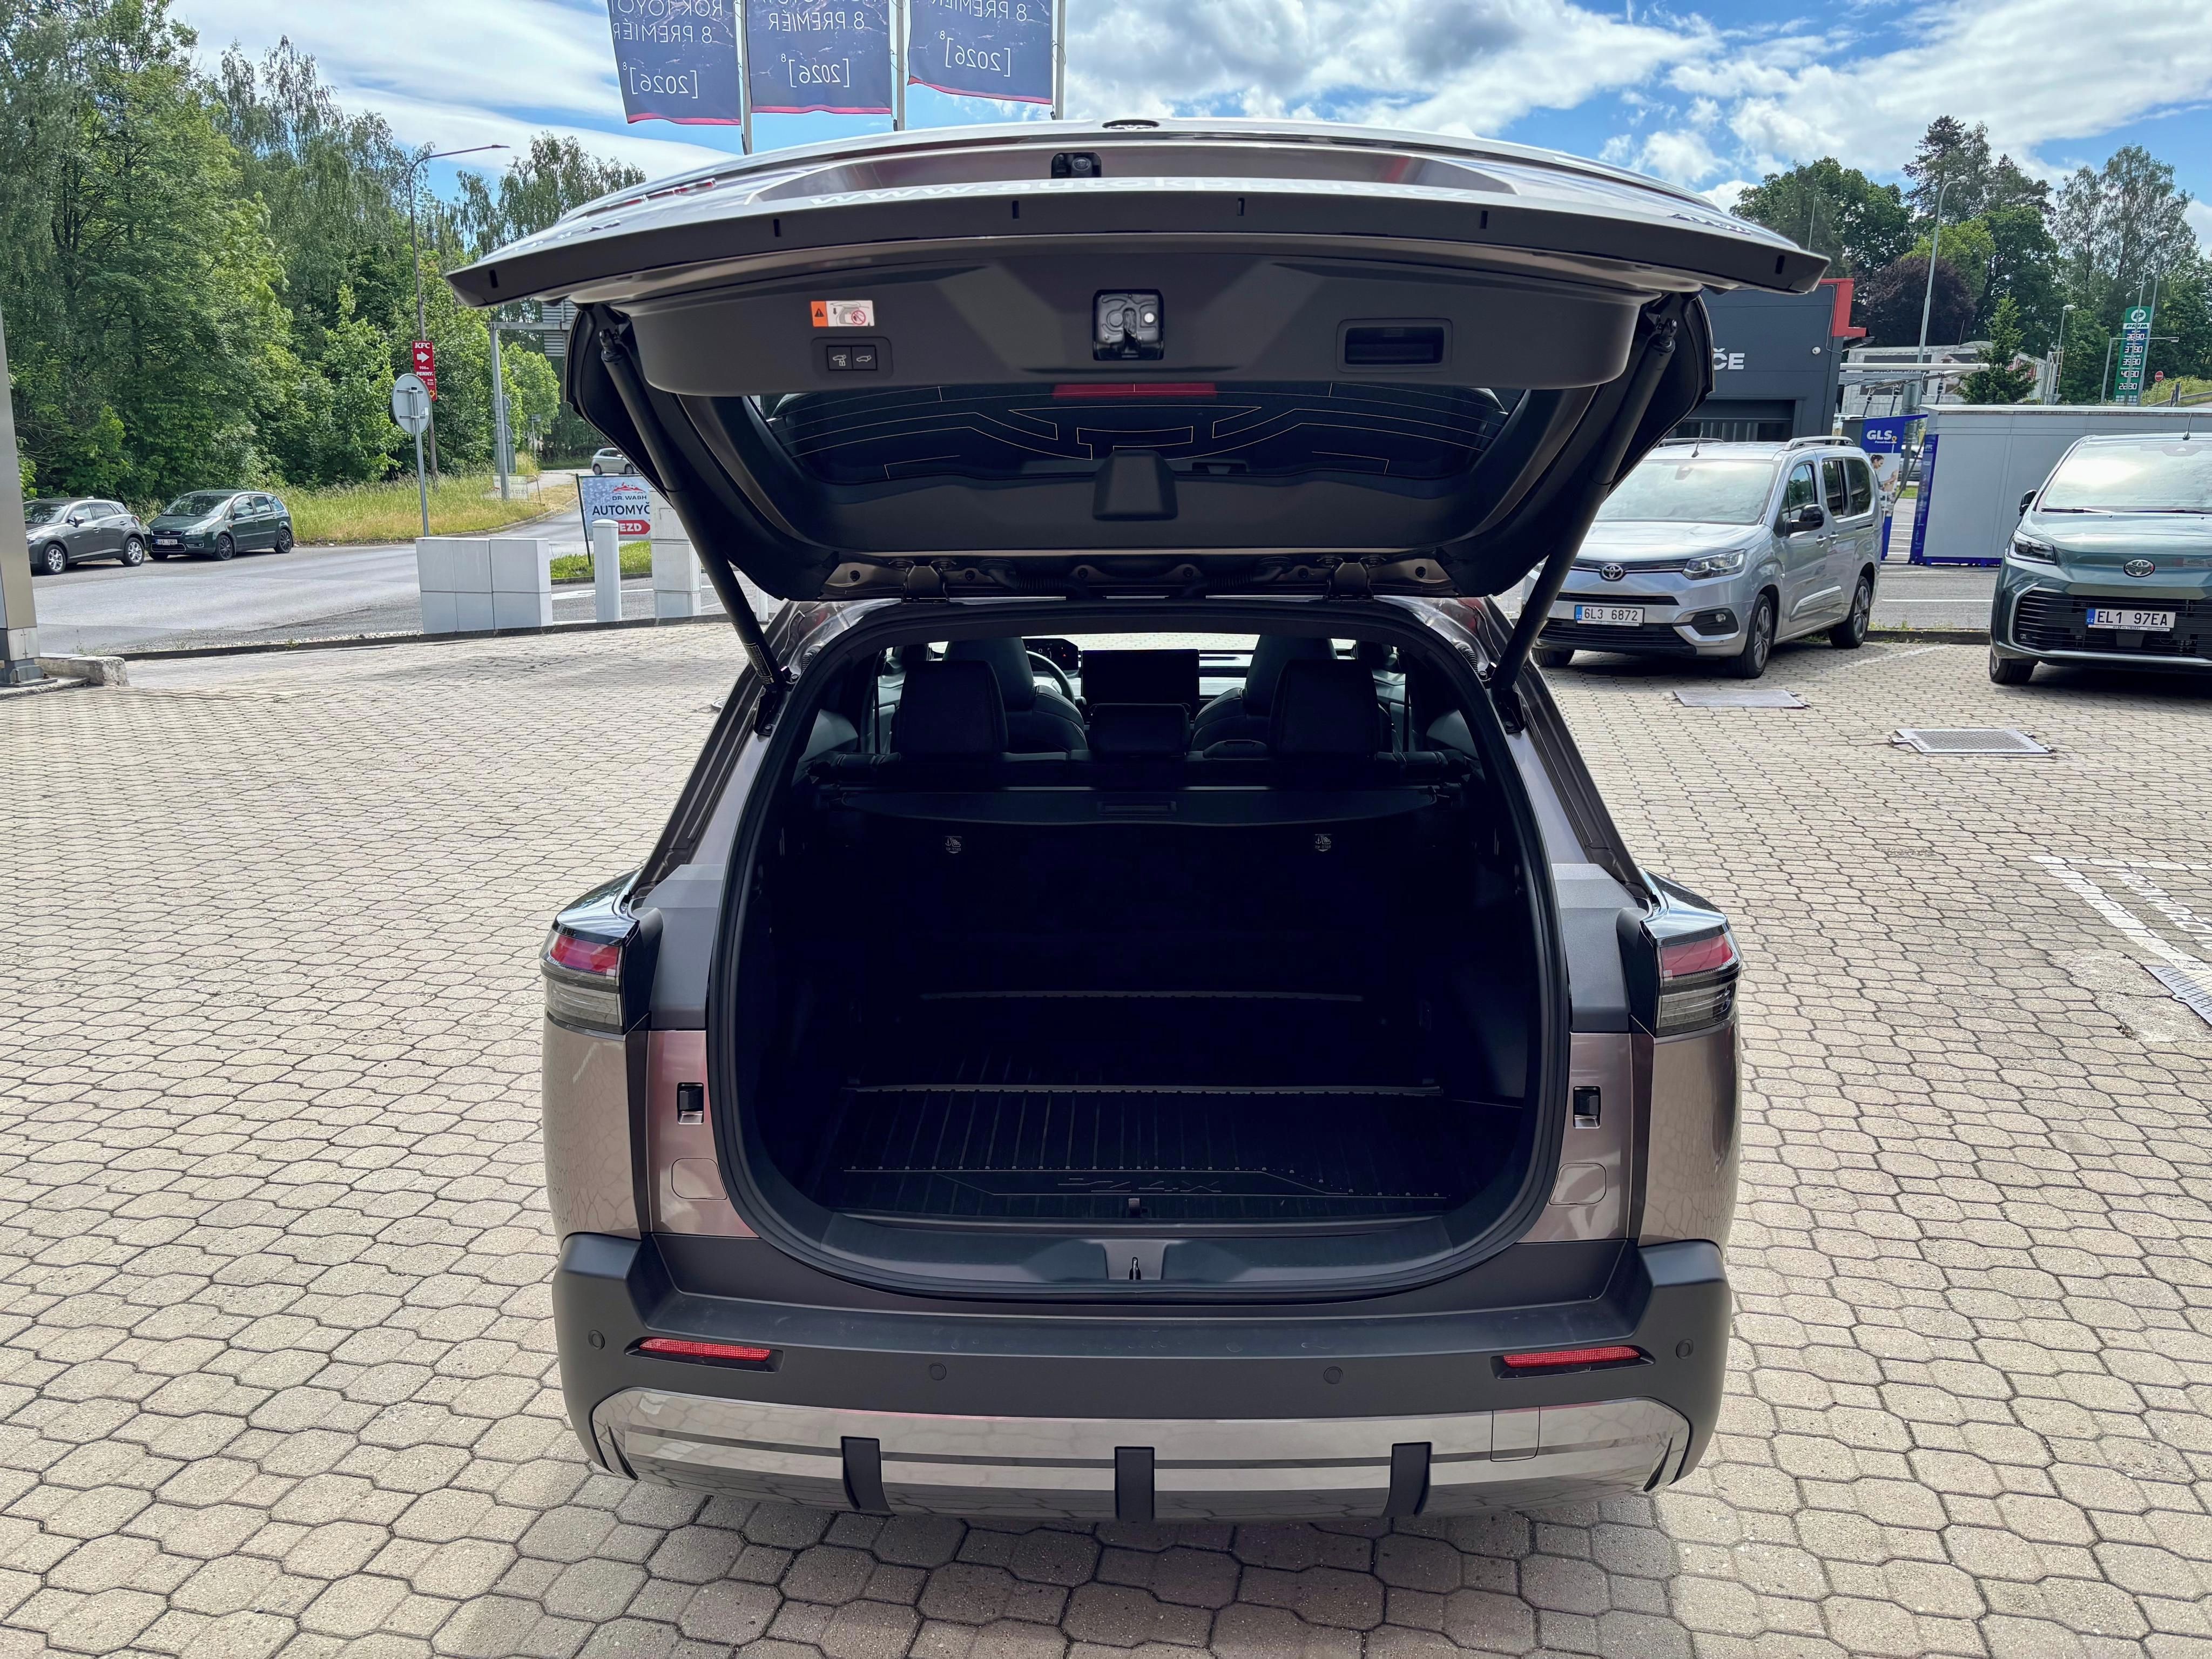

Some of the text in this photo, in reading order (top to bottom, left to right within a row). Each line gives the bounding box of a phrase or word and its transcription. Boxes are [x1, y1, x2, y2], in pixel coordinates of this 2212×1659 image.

[1584, 608, 1603, 619] 6L3
[1611, 609, 1638, 621] 6872
[2097, 611, 2123, 624] EL1
[2134, 612, 2168, 625] 97EA
